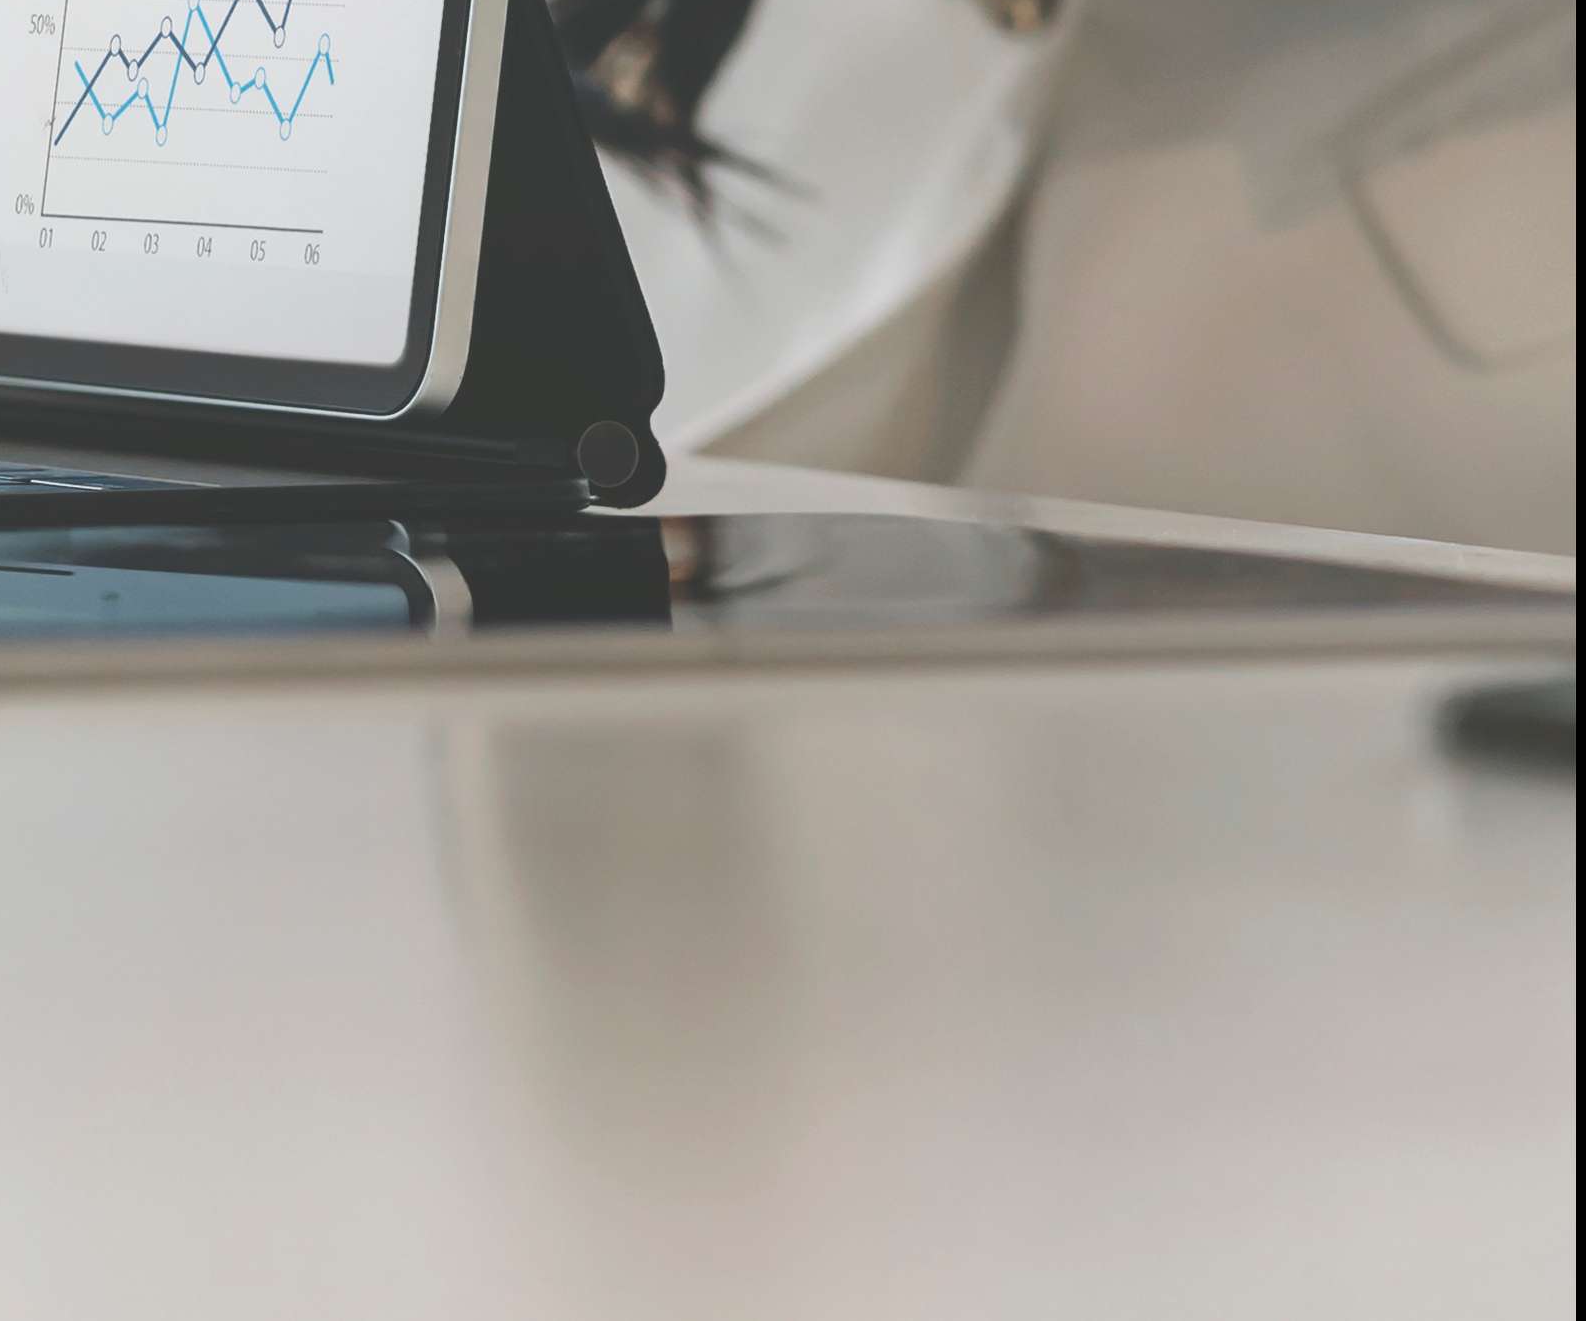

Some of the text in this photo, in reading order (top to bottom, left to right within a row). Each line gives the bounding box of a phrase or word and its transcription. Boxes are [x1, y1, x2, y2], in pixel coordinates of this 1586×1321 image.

[29, 14, 56, 35] 50%
[15, 194, 34, 215] 0%
[39, 228, 320, 264] 01 02 03 04 05 06
